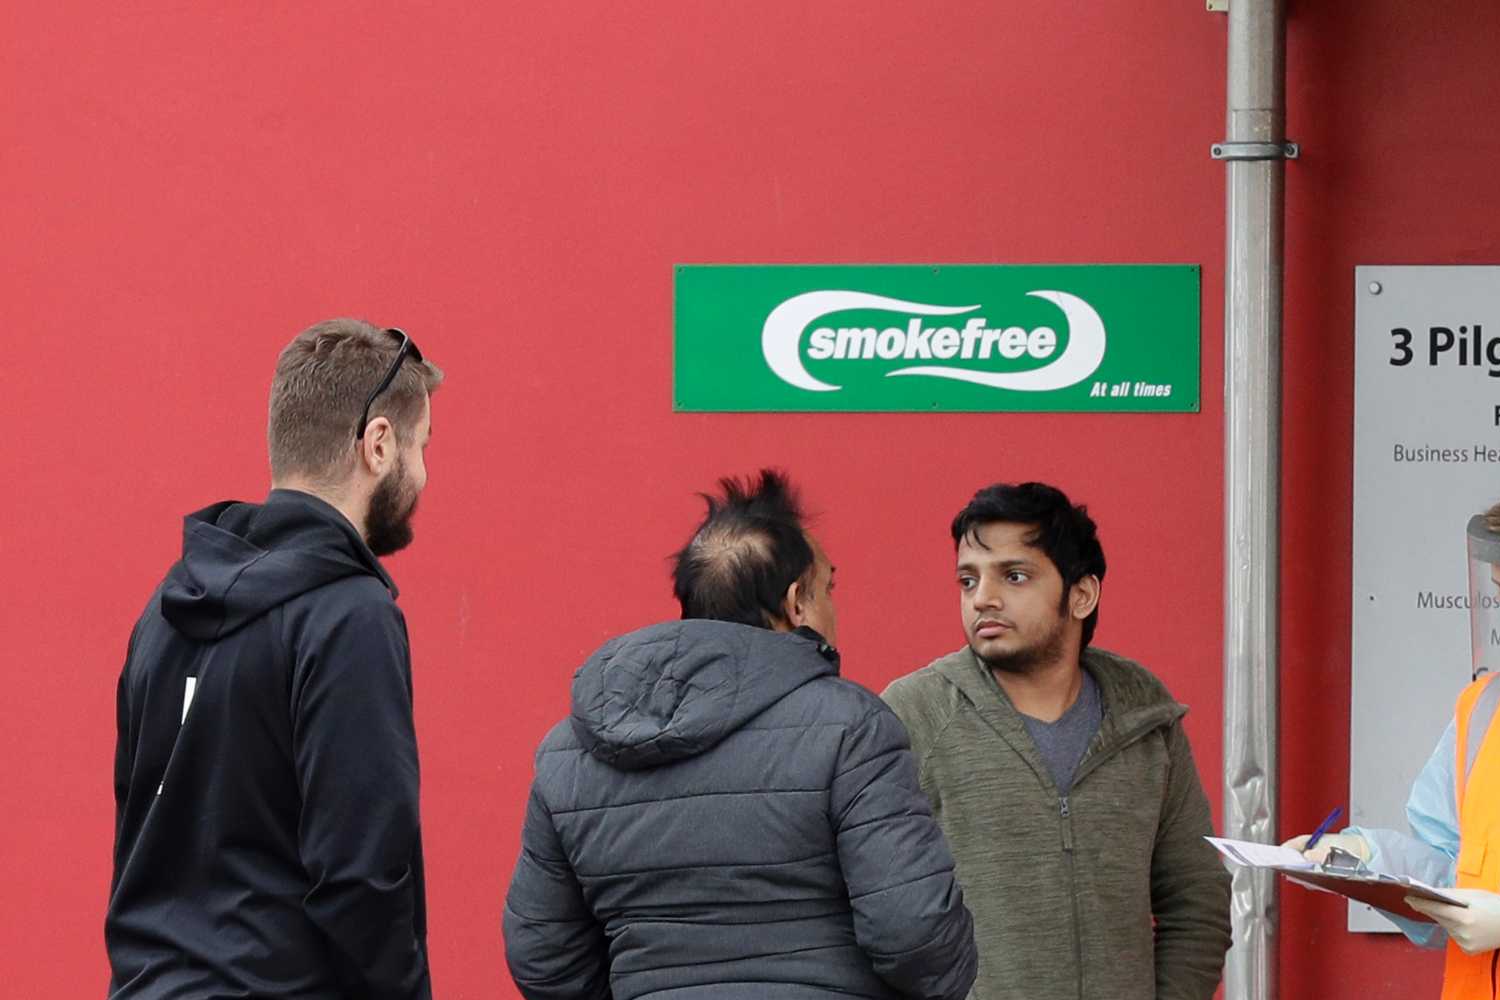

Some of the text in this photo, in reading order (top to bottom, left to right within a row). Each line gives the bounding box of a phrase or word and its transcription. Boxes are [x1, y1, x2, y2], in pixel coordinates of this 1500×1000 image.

[806, 317, 1057, 361] smokefree
[1390, 328, 1413, 366] 3
[1090, 382, 1171, 396] At all times
[1394, 444, 1468, 462] Business
